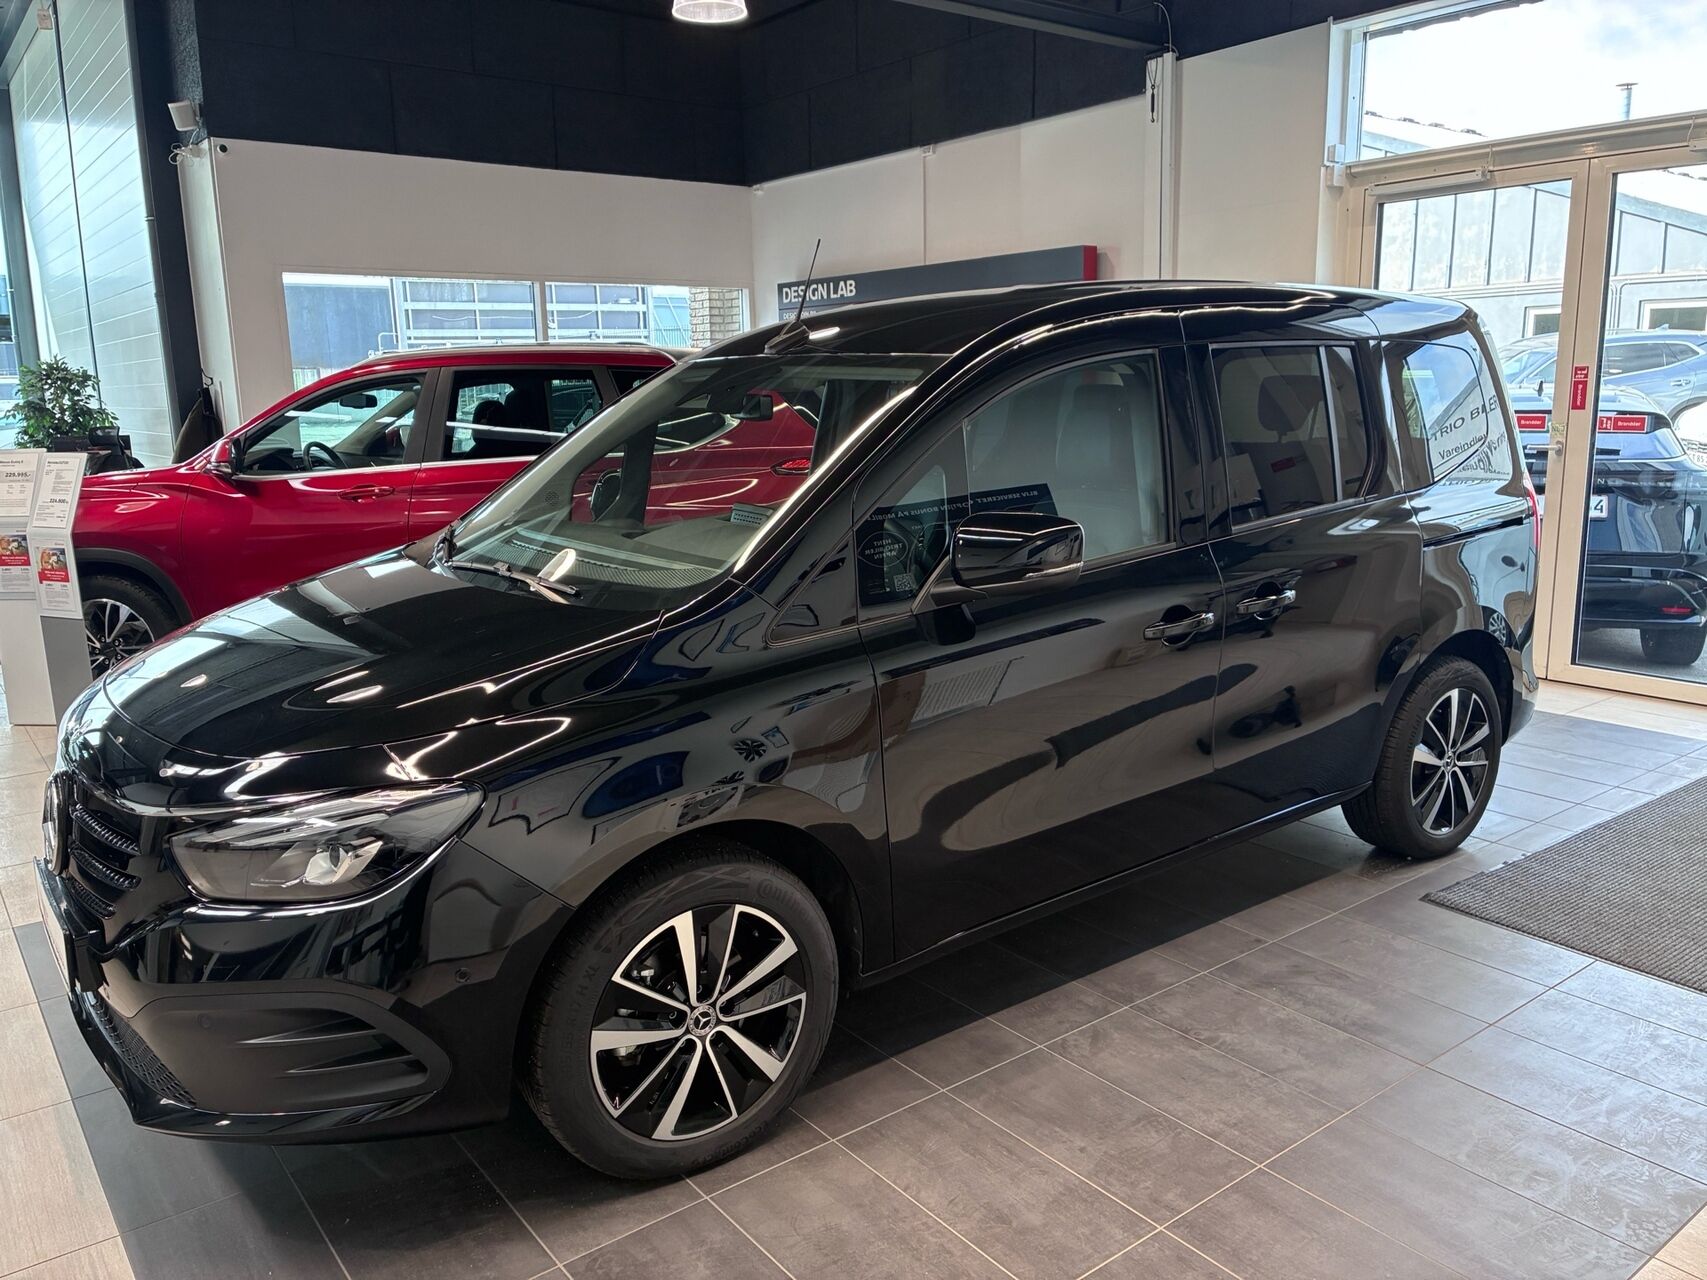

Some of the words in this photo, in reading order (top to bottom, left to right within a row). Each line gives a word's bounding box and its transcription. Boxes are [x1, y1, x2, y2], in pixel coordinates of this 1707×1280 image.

[782, 283, 827, 303] DESIGN
[830, 280, 857, 298] LAB
[1430, 416, 1466, 441] TRIO
